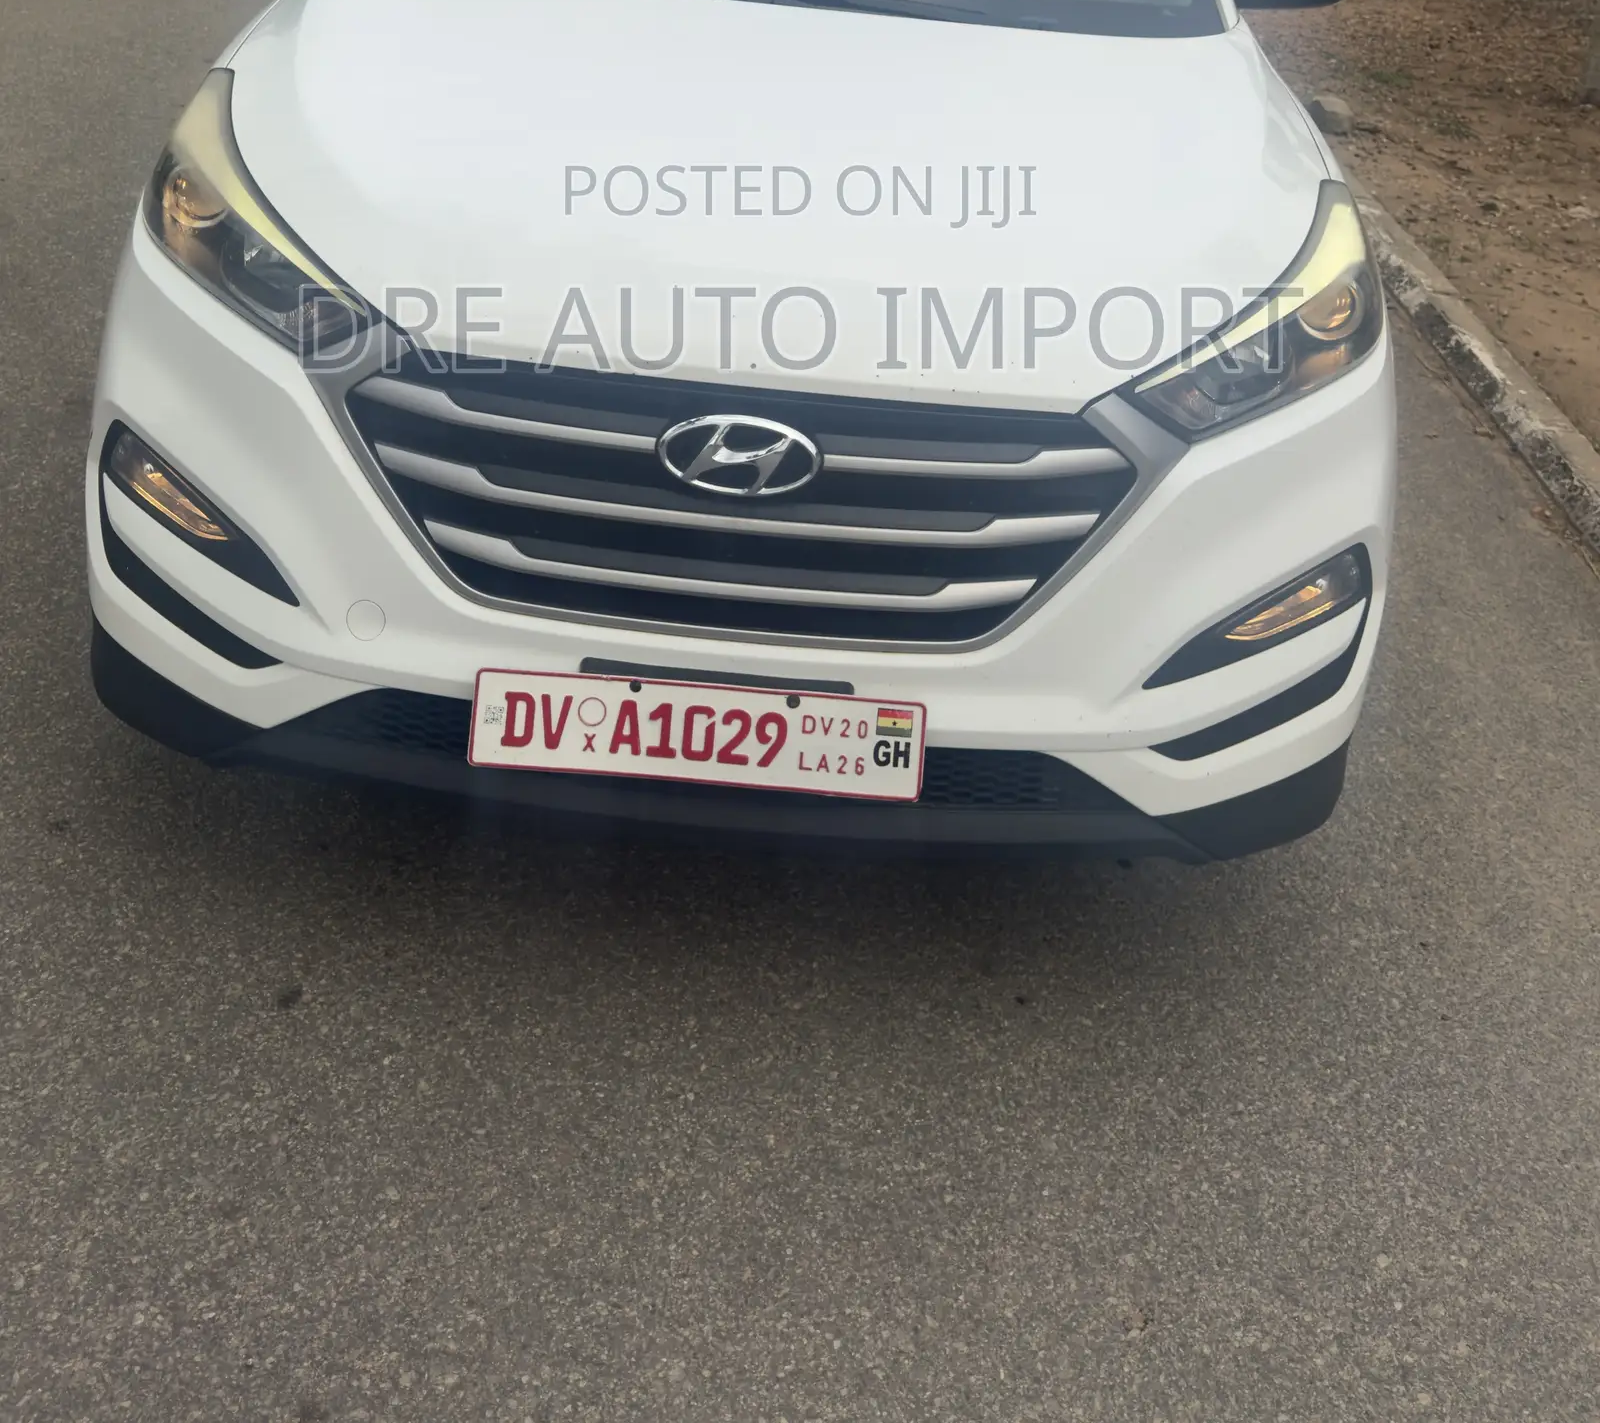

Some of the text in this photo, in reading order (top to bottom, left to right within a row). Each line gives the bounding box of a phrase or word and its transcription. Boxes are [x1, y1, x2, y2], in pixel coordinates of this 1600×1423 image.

[501, 691, 574, 750] DV
[609, 699, 788, 768] A1029
[873, 739, 911, 769] GH
